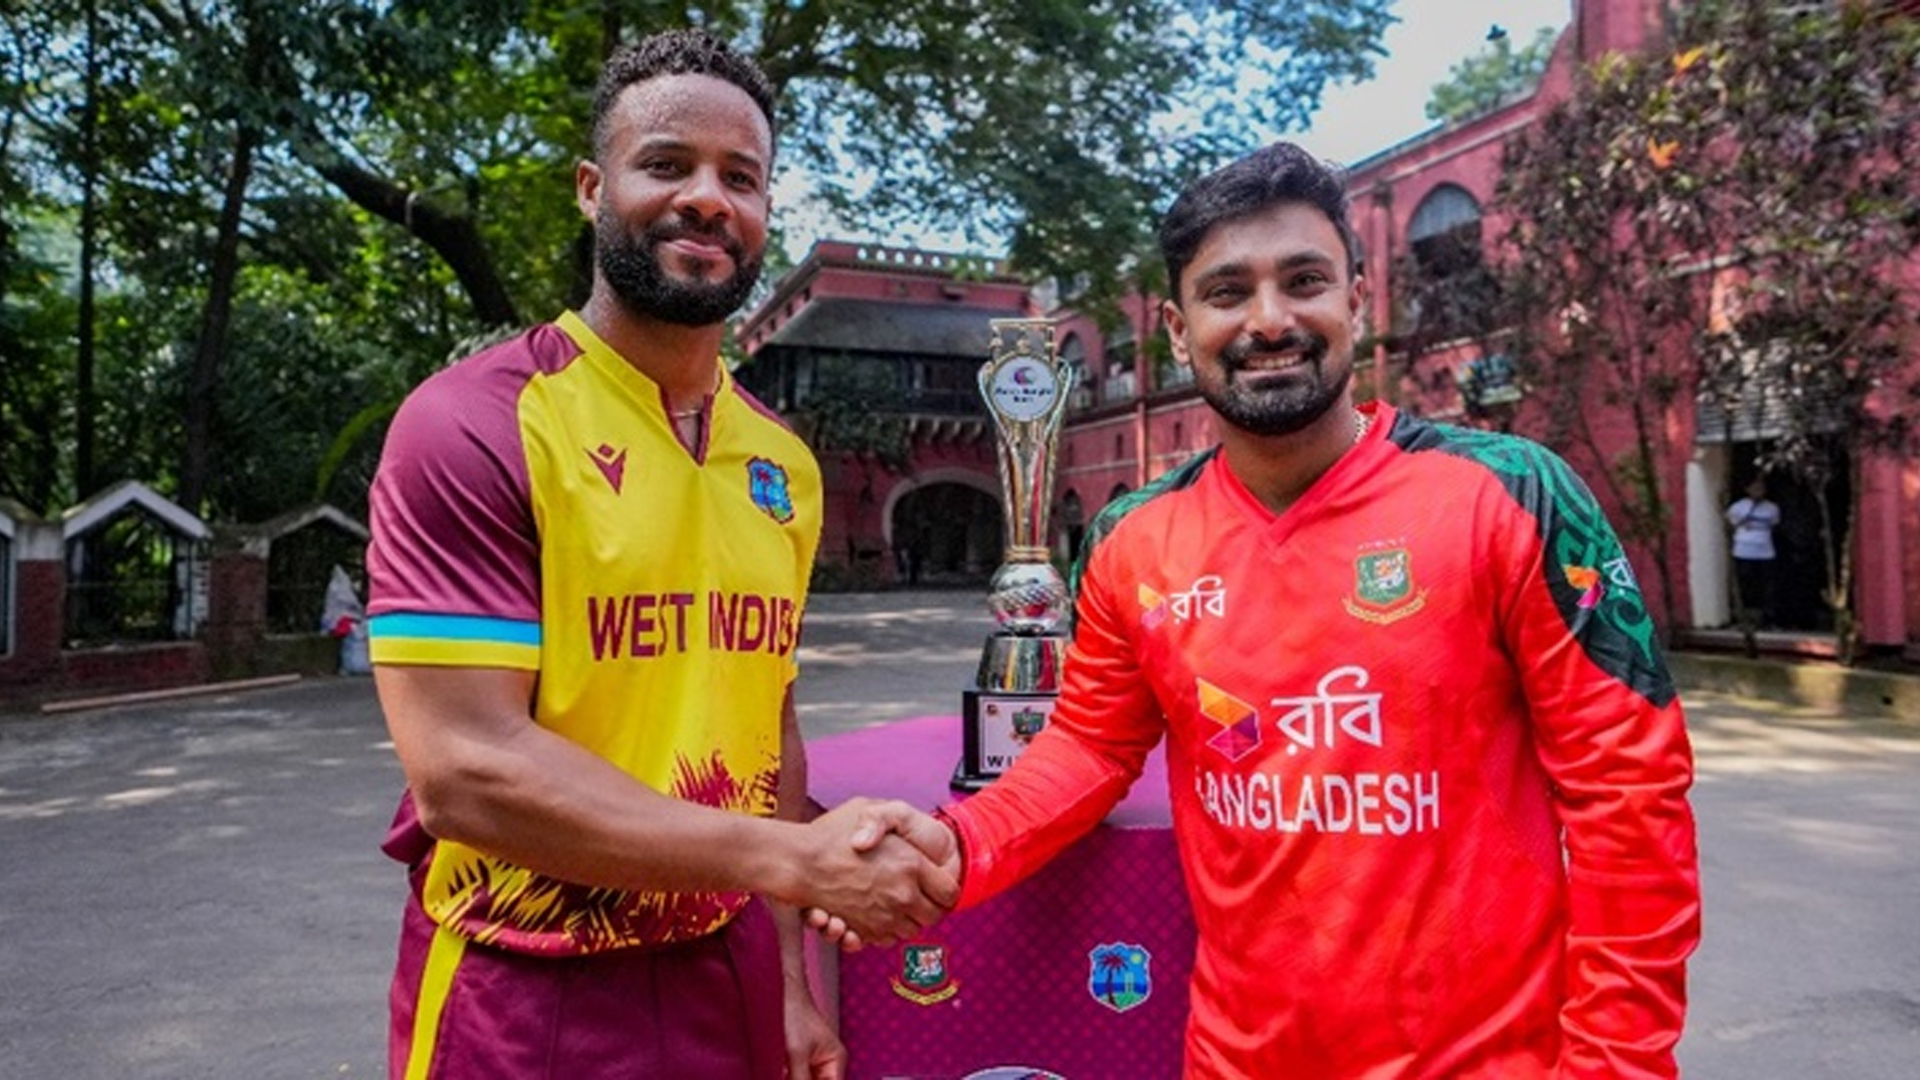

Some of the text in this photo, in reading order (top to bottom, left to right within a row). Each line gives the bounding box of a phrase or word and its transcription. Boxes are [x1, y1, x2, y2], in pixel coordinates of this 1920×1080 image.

[588, 593, 694, 661] WEST
[1170, 574, 1226, 625] রবি
[1271, 665, 1383, 756] রবি
